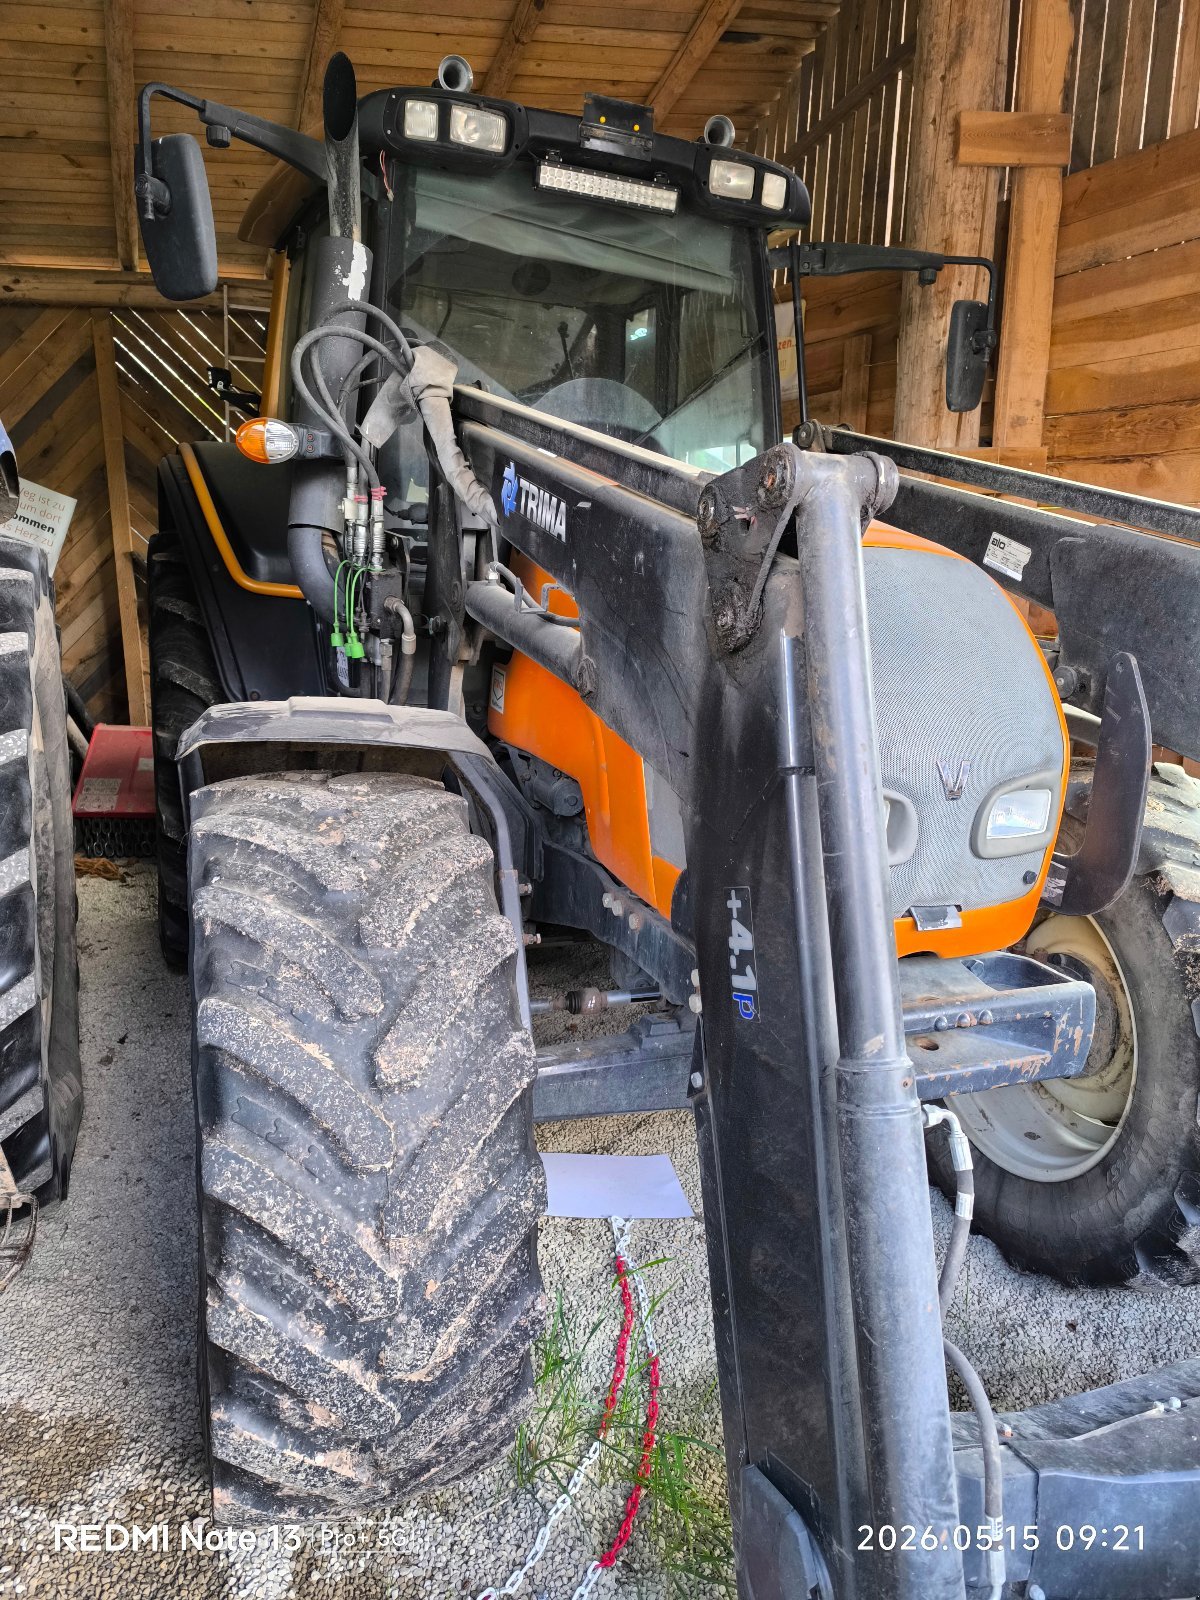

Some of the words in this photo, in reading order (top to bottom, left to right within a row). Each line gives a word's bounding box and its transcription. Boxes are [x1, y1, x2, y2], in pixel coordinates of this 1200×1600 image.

[38, 495, 50, 505] ist
[52, 501, 65, 512] zu
[519, 478, 567, 543] TRIMA
[12, 513, 57, 536] ommen,
[39, 508, 62, 522] dort
[2, 523, 12, 532] as
[14, 525, 39, 540] Herz
[41, 538, 54, 547] zu
[991, 538, 1006, 550] alo
